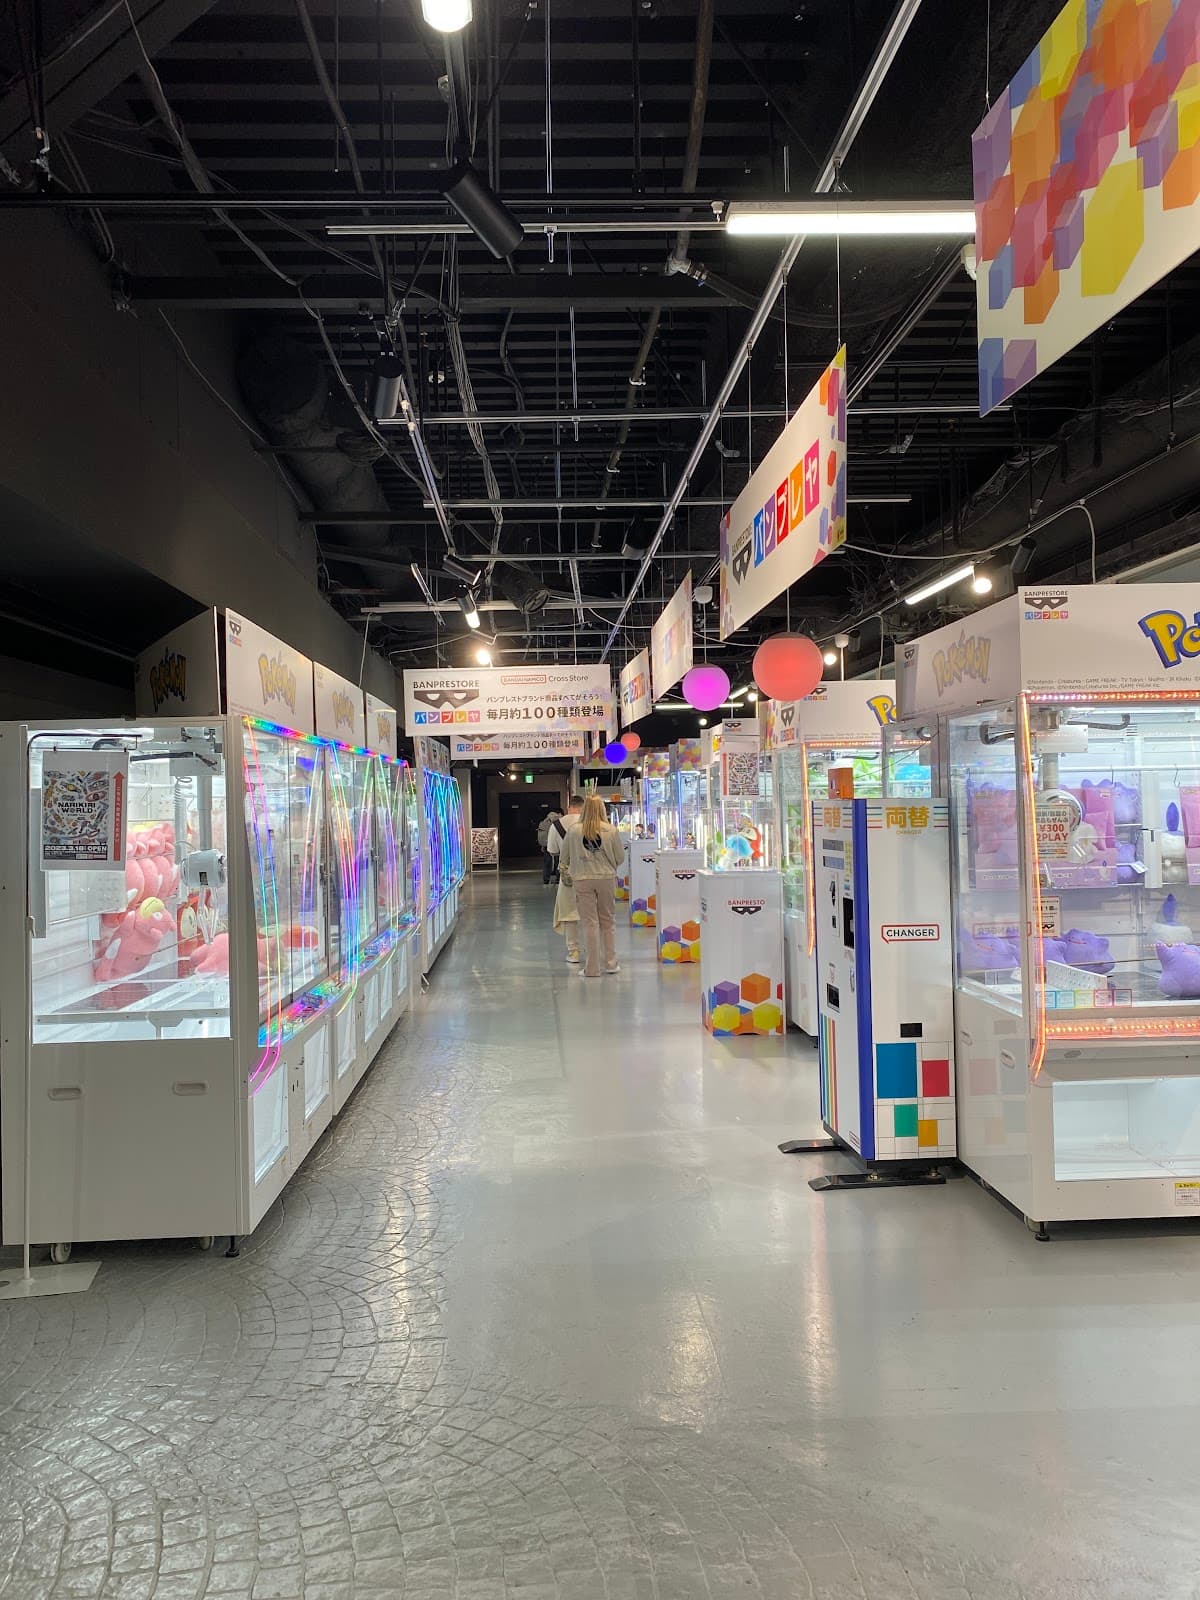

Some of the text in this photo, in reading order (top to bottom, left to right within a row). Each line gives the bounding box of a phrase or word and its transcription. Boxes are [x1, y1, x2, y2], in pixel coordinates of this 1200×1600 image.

[1138, 609, 1200, 669] Po
[413, 680, 479, 688] BANPRESTORE
[487, 705, 604, 720] 毎月約100種類登場
[885, 806, 930, 829] 両替
[1039, 824, 1064, 832] ¥300
[886, 929, 935, 937] CHANGER
